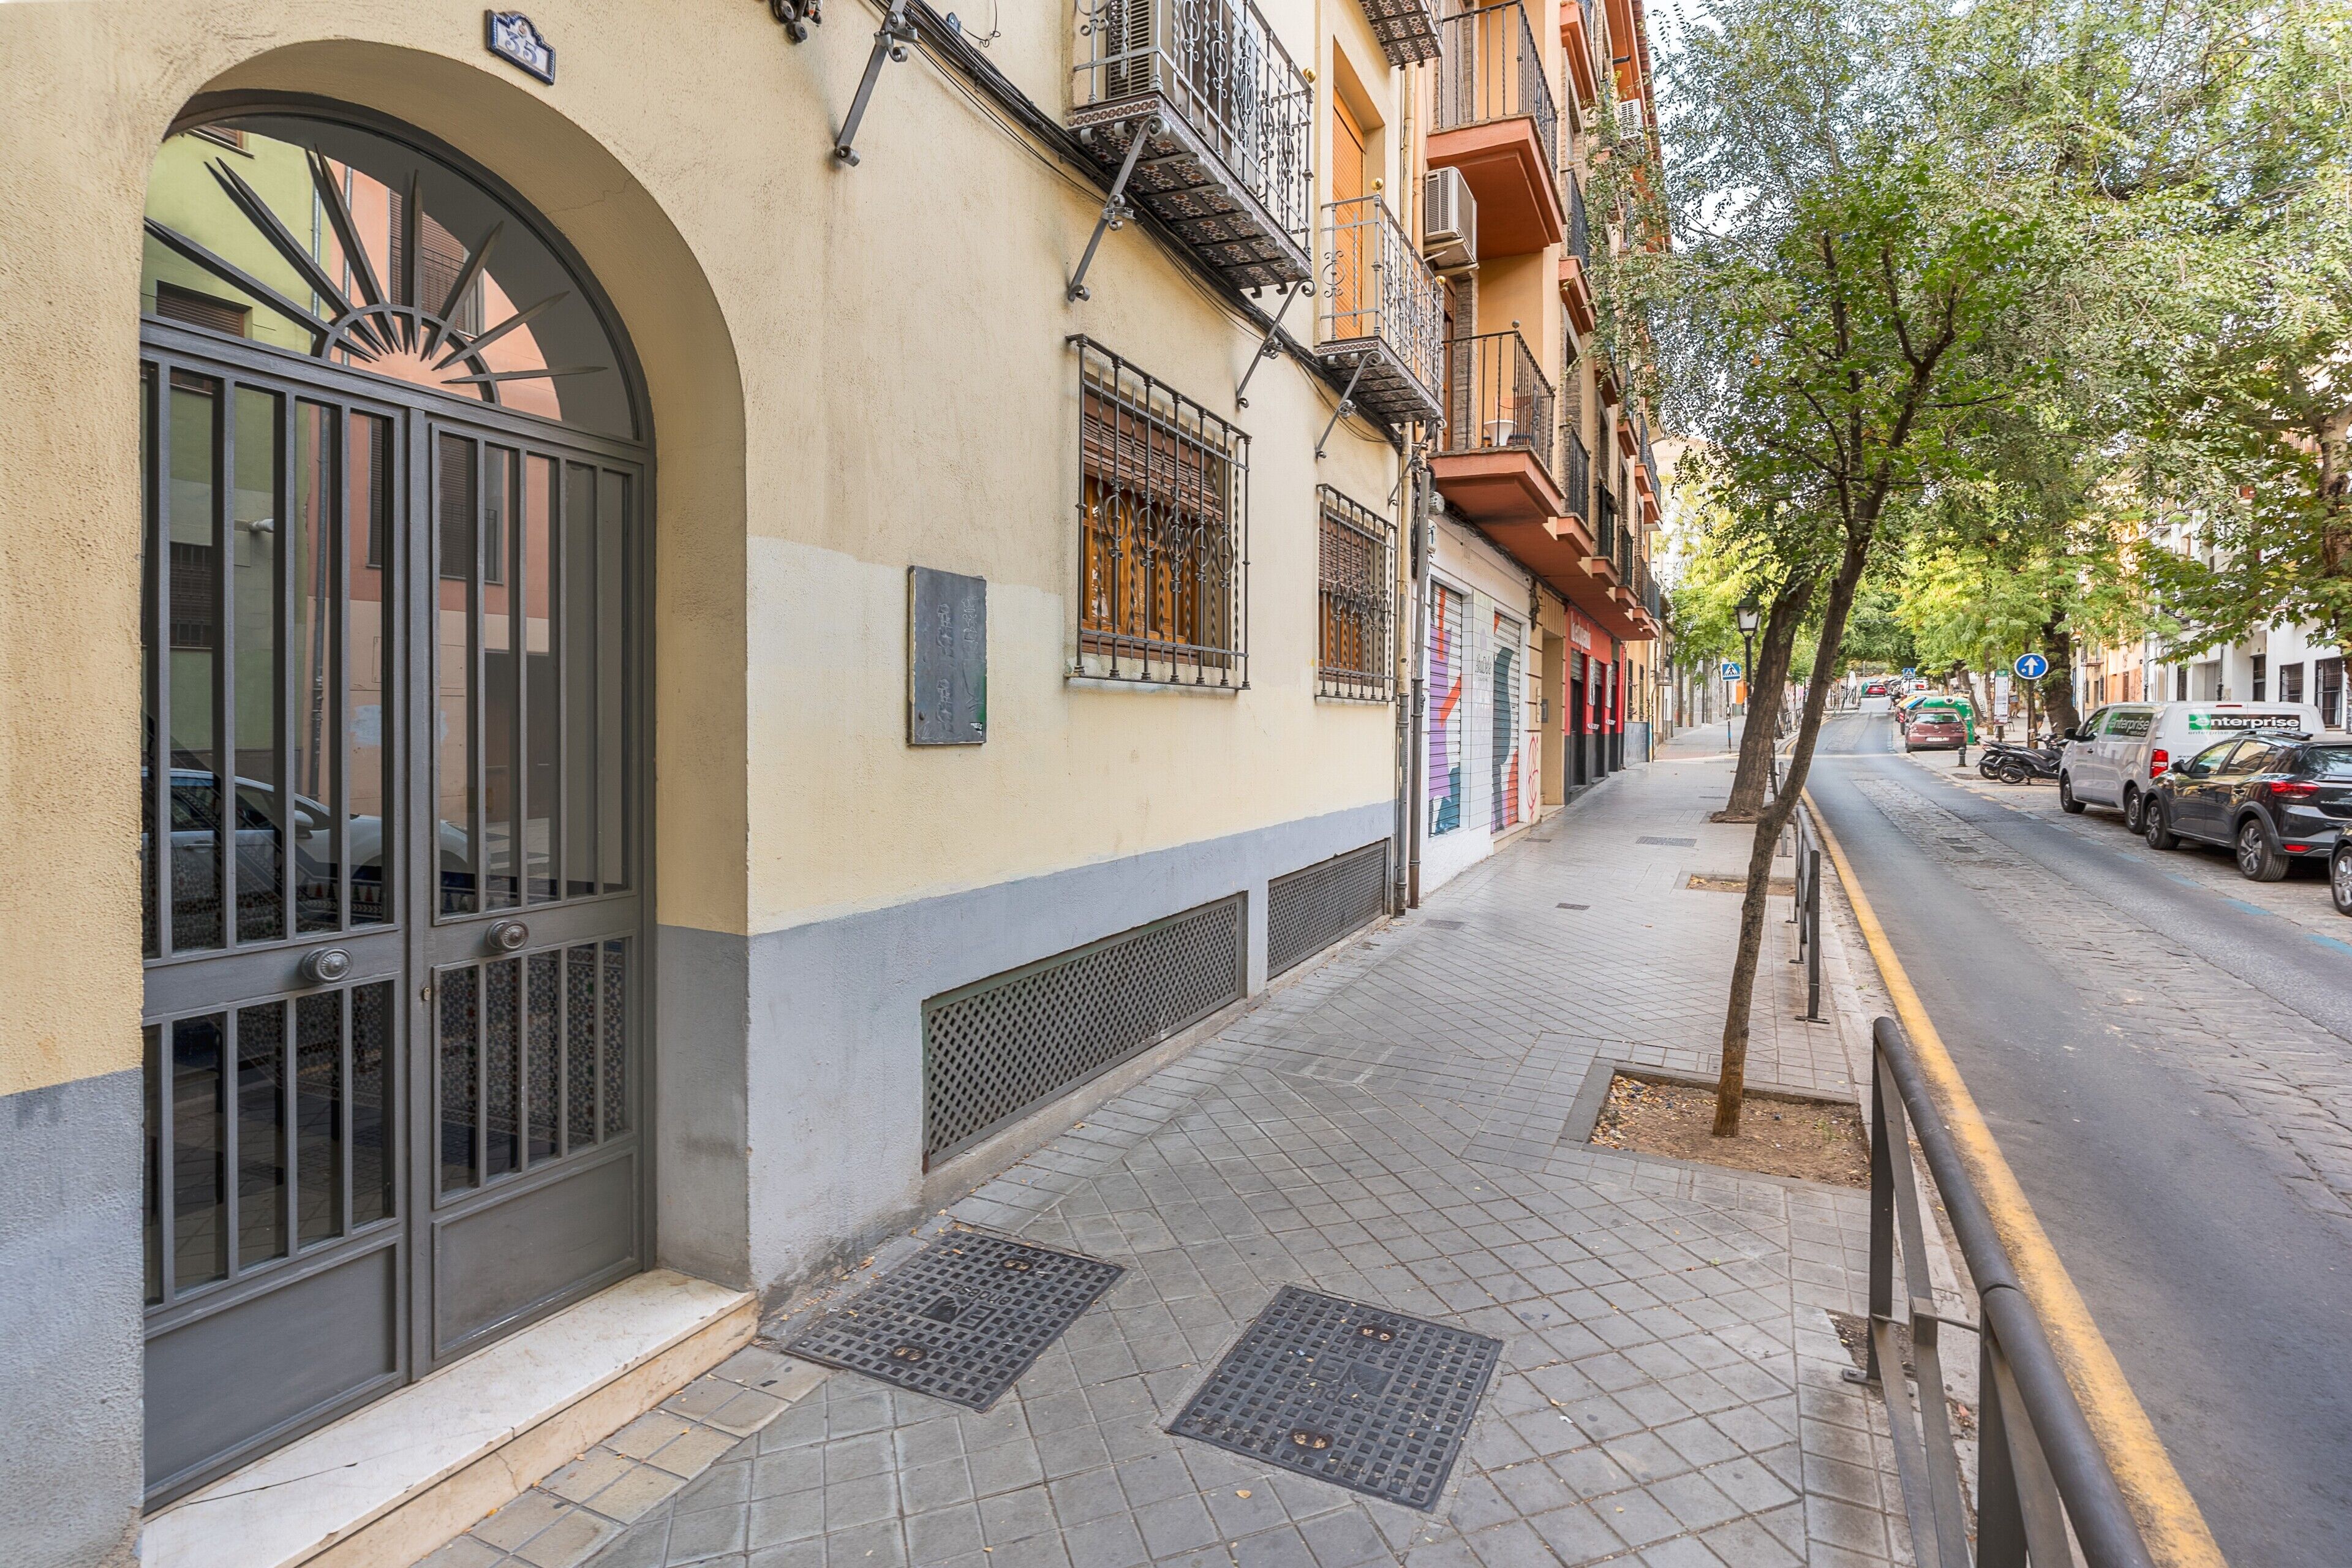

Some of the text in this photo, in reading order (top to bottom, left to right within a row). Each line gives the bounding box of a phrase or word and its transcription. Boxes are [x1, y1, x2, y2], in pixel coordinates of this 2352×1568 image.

[2109, 717, 2149, 733] enterprise
[2192, 716, 2299, 729] enterprise
[949, 1283, 1012, 1305] endesa
[1298, 1382, 1378, 1414] endesa
